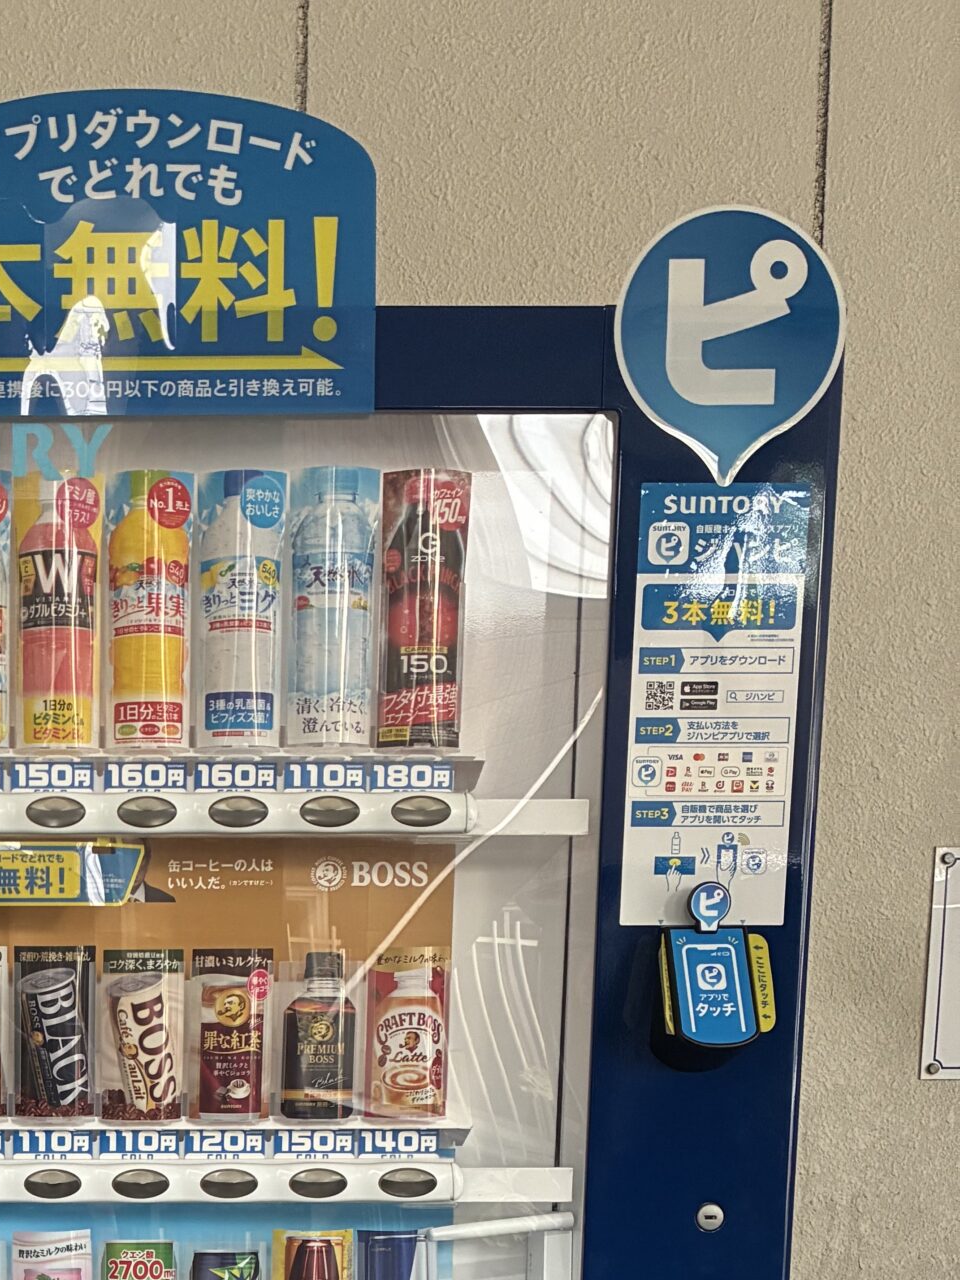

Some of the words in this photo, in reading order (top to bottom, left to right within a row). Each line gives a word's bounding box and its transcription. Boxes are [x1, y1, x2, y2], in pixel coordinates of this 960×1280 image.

[39, 157, 243, 206] でどれでも
[666, 240, 808, 405] ピ
[246, 488, 280, 503] 爽やかな
[246, 503, 279, 517] おいしさ
[643, 655, 676, 667] STEP1
[690, 655, 786, 666] アプリをダウンロード
[43, 699, 73, 712] 1日分の
[640, 724, 673, 737] STEP2
[15, 763, 91, 787] 150円
[107, 763, 185, 787] 160円
[197, 764, 275, 787] 160円
[290, 764, 366, 787] 110円
[374, 764, 453, 788] 180円
[636, 808, 669, 820] STEP3
[168, 859, 273, 873] 缶コーヒーの人は
[351, 861, 429, 887] BOSS
[168, 875, 226, 890] いい人だ。
[699, 993, 729, 1001] アプリで
[695, 1002, 736, 1017] タッチ
[36, 979, 90, 1105] BLACK
[130, 993, 177, 1103] BOSS
[203, 1030, 262, 1050] 罪な紅茶
[309, 1056, 335, 1064] BOSS
[15, 1130, 90, 1151] 110円
[102, 1130, 177, 1151] 110円
[188, 1130, 264, 1151] 120円
[276, 1131, 352, 1151] 150円
[360, 1131, 437, 1151] 140円
[18, 1244, 87, 1259] 贅沢なミルクの味わい
